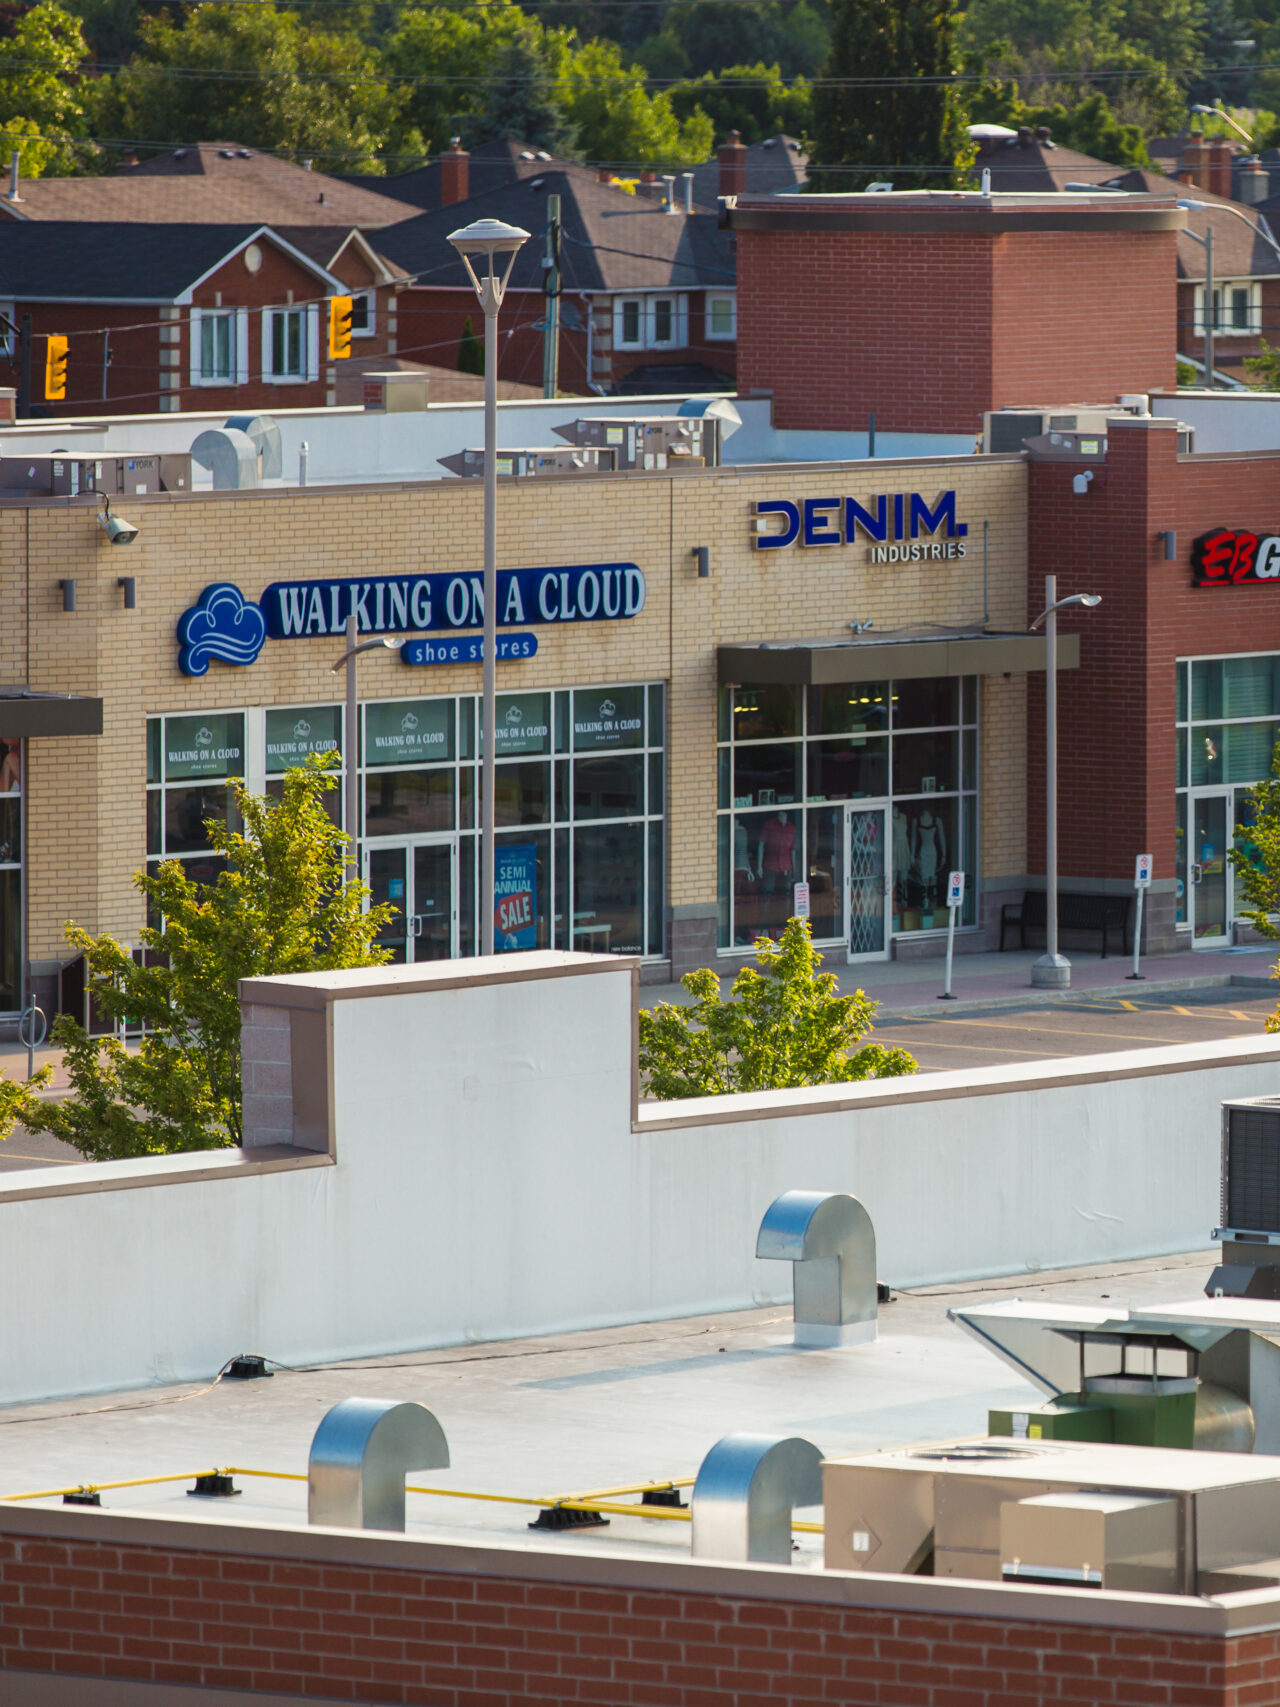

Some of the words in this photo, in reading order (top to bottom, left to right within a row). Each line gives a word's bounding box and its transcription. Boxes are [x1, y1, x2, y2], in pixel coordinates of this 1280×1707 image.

[871, 543, 967, 563] INDUSTRIES
[1201, 531, 1258, 581] EB
[278, 579, 432, 636] WALKING
[503, 575, 525, 622] A
[538, 569, 647, 621] CLOUD
[415, 642, 459, 662] shoe
[469, 640, 530, 659] stres
[510, 727, 520, 738] ON
[519, 727, 526, 737] A
[526, 725, 548, 737] CLOUD
[574, 722, 603, 733] WALKING
[603, 721, 614, 731] ON
[613, 721, 619, 731] A
[620, 719, 641, 730] CLOUD
[267, 742, 296, 754] WALKING
[297, 742, 309, 753] ON
[308, 742, 314, 752] A
[315, 739, 338, 751] CLOUD
[375, 735, 405, 747] WALKING
[405, 734, 417, 745] ON
[416, 734, 422, 745] A
[422, 732, 445, 744] CLOUD
[168, 751, 198, 763] WALKING
[200, 750, 211, 761] ON
[210, 750, 216, 760] A
[217, 748, 240, 760] CLOUD
[500, 866, 526, 880] SEMI
[494, 879, 532, 894] ANNUAL
[500, 896, 531, 931] SALE
